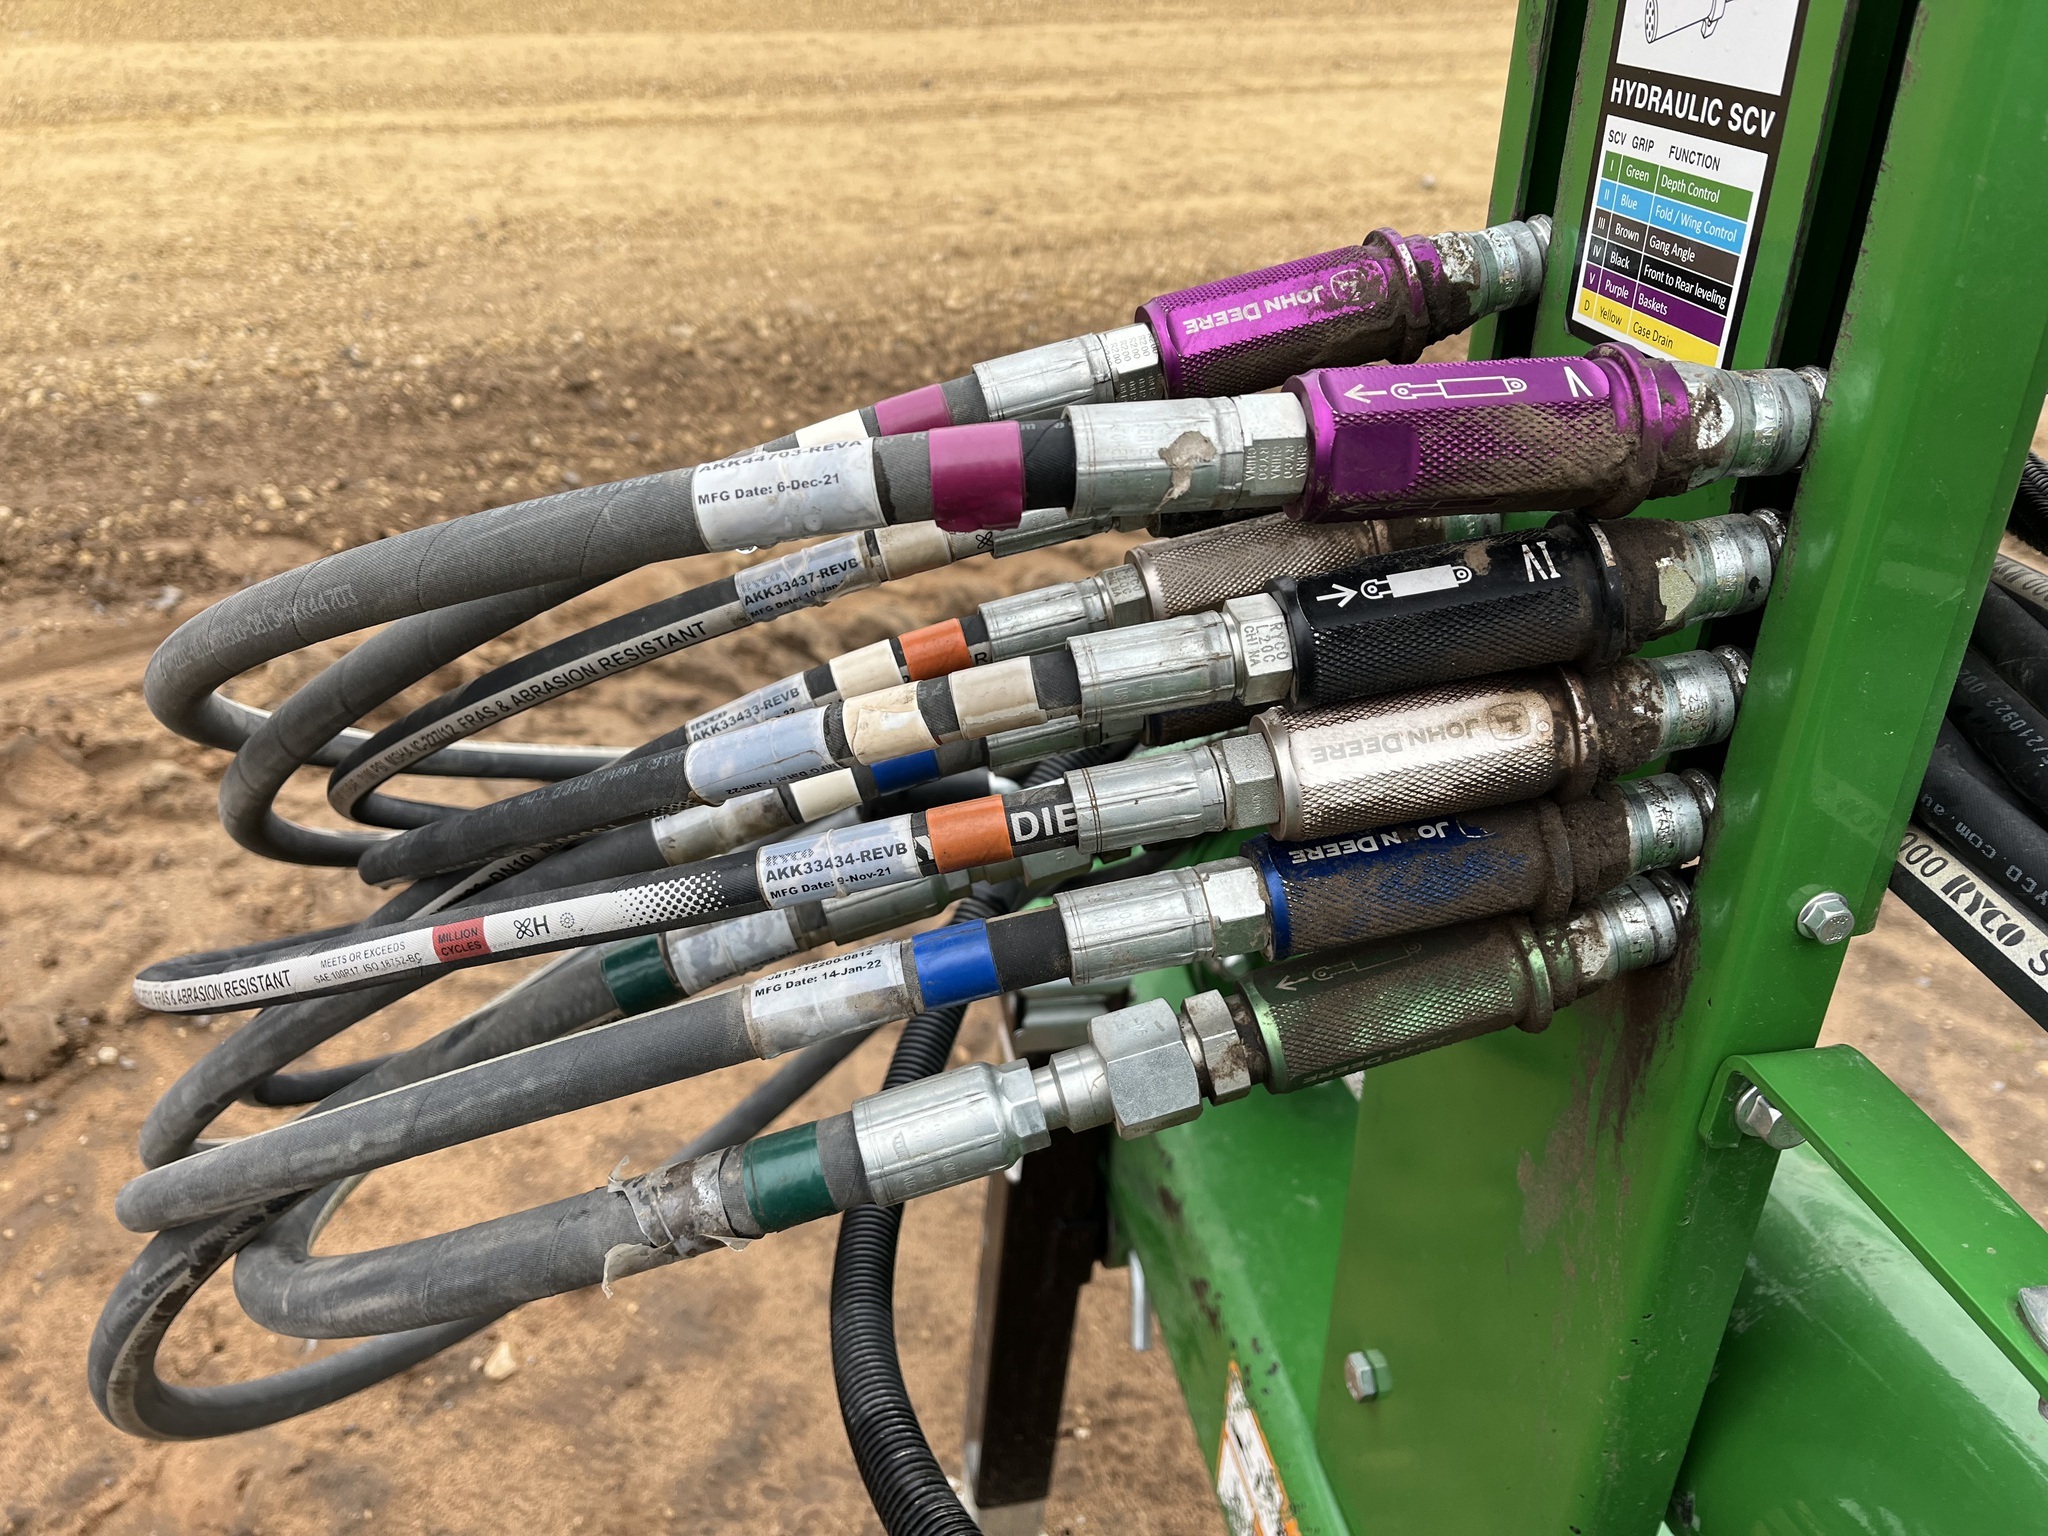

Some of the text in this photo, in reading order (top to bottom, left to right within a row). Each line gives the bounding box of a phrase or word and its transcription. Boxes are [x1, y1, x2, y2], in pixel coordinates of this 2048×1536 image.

[1610, 77, 1776, 139] HYDRAULIC SCV
[1607, 129, 1721, 172] SCV GRIP FUNCTION
[1626, 163, 1650, 183] Green
[1661, 174, 1687, 197] Depth
[1687, 181, 1720, 204] Control
[1603, 188, 1610, 201] II
[1620, 193, 1638, 210] Blue
[1655, 204, 1672, 222] Fold
[1680, 213, 1703, 235] Wing
[1703, 220, 1737, 243] Control
[1597, 215, 1696, 263] III Brown Gang Angle
[1588, 272, 1668, 316] V Purple Baskets
[1592, 244, 1727, 310] IV Black Front to Rear leveling
[1183, 284, 1324, 336] JOHN DEERE
[1583, 299, 1674, 349] D Yellow Case Drain
[697, 473, 840, 506] MFG Date: 6-Dec-21
[743, 557, 860, 607] AKK33437-REVB
[1521, 541, 1561, 583] IV
[1255, 623, 1276, 664] L20C
[1268, 621, 1290, 661] RYCO
[457, 620, 709, 736] FRAS & ABRASION RESISTANT
[693, 687, 800, 742] AKK33433-REVB
[1311, 716, 1480, 765] JOHN DEERE
[765, 842, 908, 884] AKK33434-REVB
[1288, 821, 1450, 864] JON DEERE
[769, 866, 891, 900] MFG Date: 9-Nov-21
[1940, 874, 2026, 947] RYCO
[320, 942, 406, 969] MEETS OR EXCEEDS
[437, 927, 478, 944] MILLION
[441, 941, 483, 957] CYCLES
[176, 982, 223, 1006] ABRASION
[224, 969, 293, 999] RESISTANT
[313, 973, 331, 984] SAE
[331, 966, 360, 982] 100R17
[363, 962, 379, 973] ISO
[755, 959, 882, 998] MFG Date: 14-Jan-22
